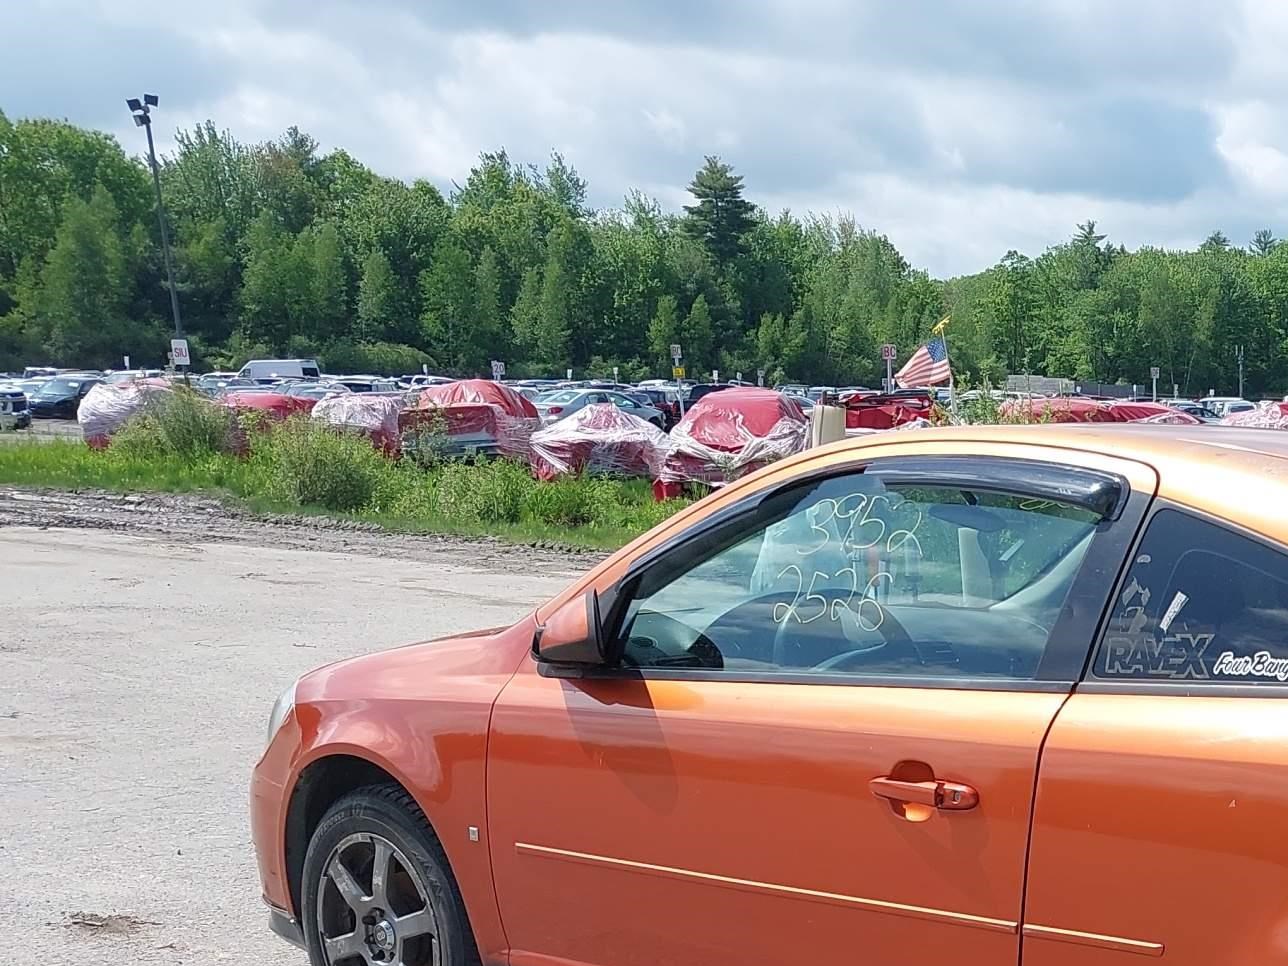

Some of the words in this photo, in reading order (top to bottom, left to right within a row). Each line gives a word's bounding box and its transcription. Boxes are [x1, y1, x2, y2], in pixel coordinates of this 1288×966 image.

[883, 346, 896, 357] BC
[796, 493, 923, 558] 3952
[772, 565, 893, 632] 2526
[1213, 651, 1251, 676] Four
